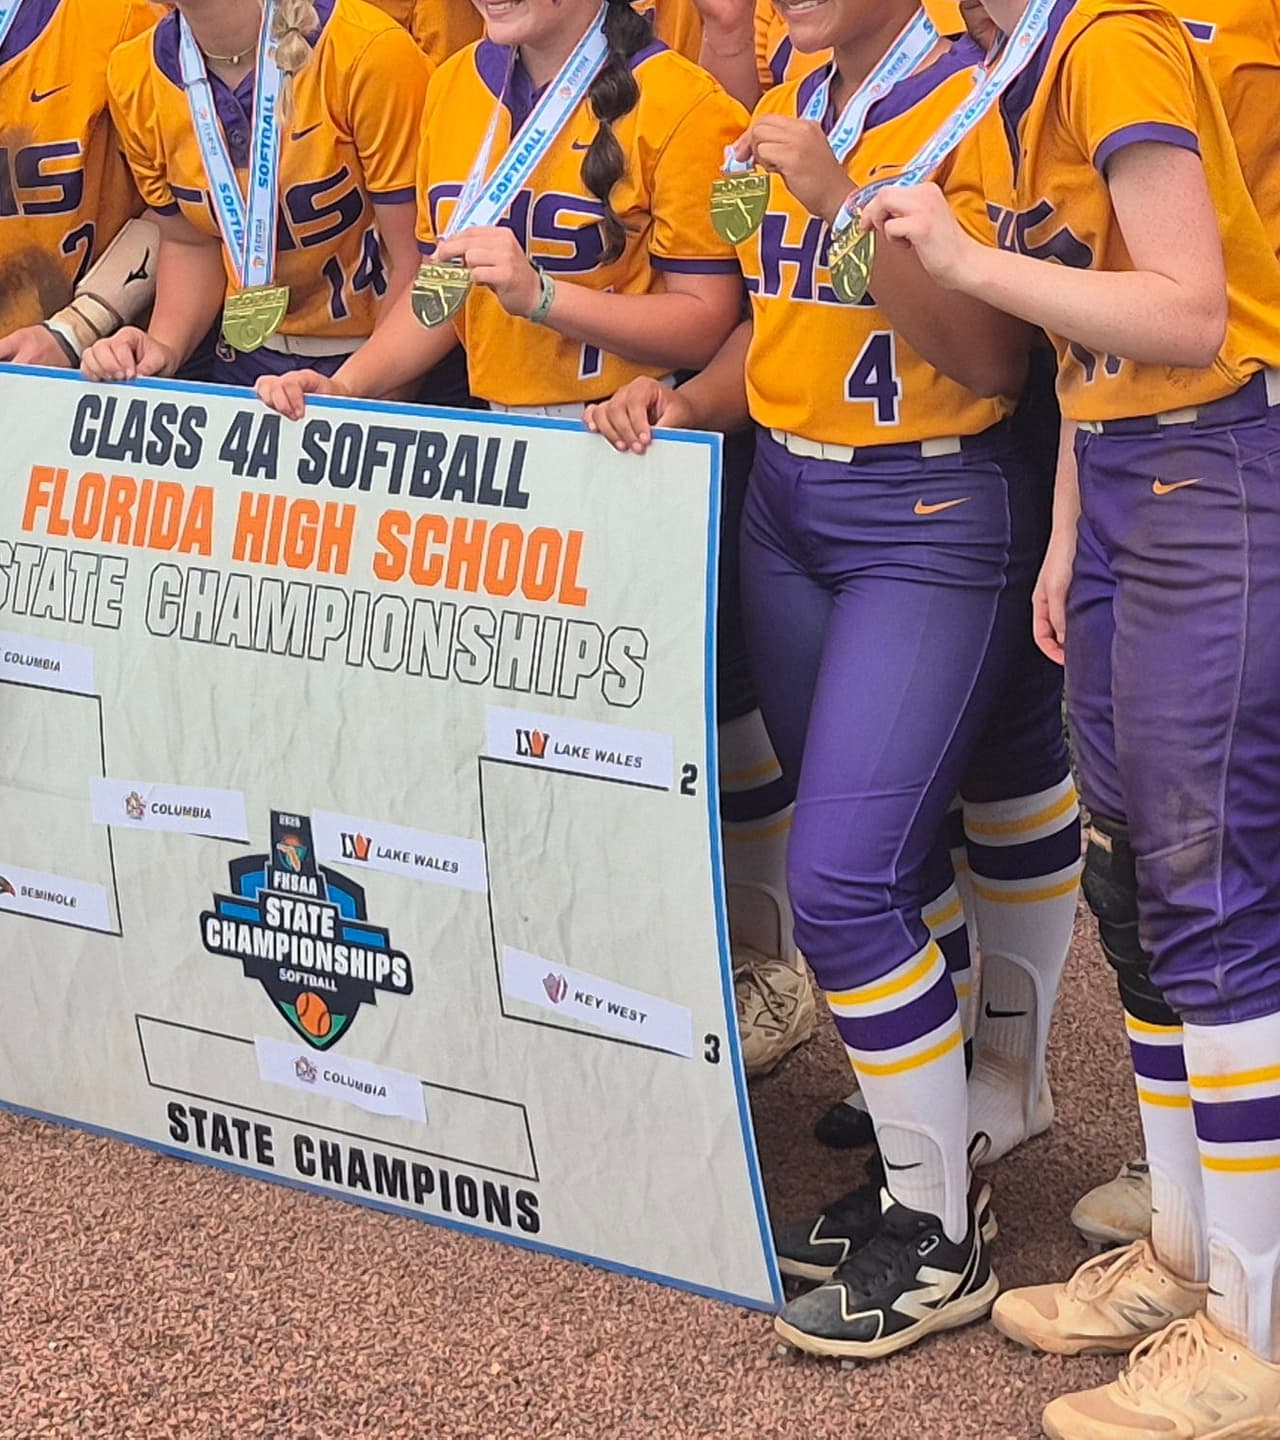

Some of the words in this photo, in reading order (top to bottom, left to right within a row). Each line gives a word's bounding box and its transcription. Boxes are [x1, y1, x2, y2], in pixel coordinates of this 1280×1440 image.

[258, 93, 275, 189] SOFTBALL
[489, 127, 547, 205] SOFTBALL
[321, 226, 389, 319] 14
[843, 329, 904, 428] 4
[69, 393, 208, 470] CLASS
[220, 410, 282, 481] 4A
[296, 417, 531, 511] SOFTBALL
[20, 464, 215, 558] FLORIDA
[231, 489, 357, 576] HIGH
[372, 507, 590, 608] SCHOOL
[143, 562, 650, 710] CHAMPIONSHIPS
[3, 650, 62, 673] COLUMBIA
[553, 741, 590, 760] LAKE
[594, 748, 643, 770] WALES
[679, 762, 699, 797] 2
[150, 801, 213, 820] COLUMBIA
[375, 845, 411, 865] LAKE
[413, 852, 460, 875] WALES
[19, 885, 78, 909] SEMINOLE
[264, 895, 337, 939] STATE
[204, 916, 409, 990] CHAMPIONSHIPS
[278, 967, 339, 993] SOFTBALL
[573, 989, 605, 1010] KEY
[606, 1000, 649, 1025] WEST
[703, 1032, 722, 1065] 3
[321, 1069, 389, 1099] COLUMBIA
[166, 1101, 276, 1168] STATE
[292, 1132, 542, 1235] CHAMPIONS
